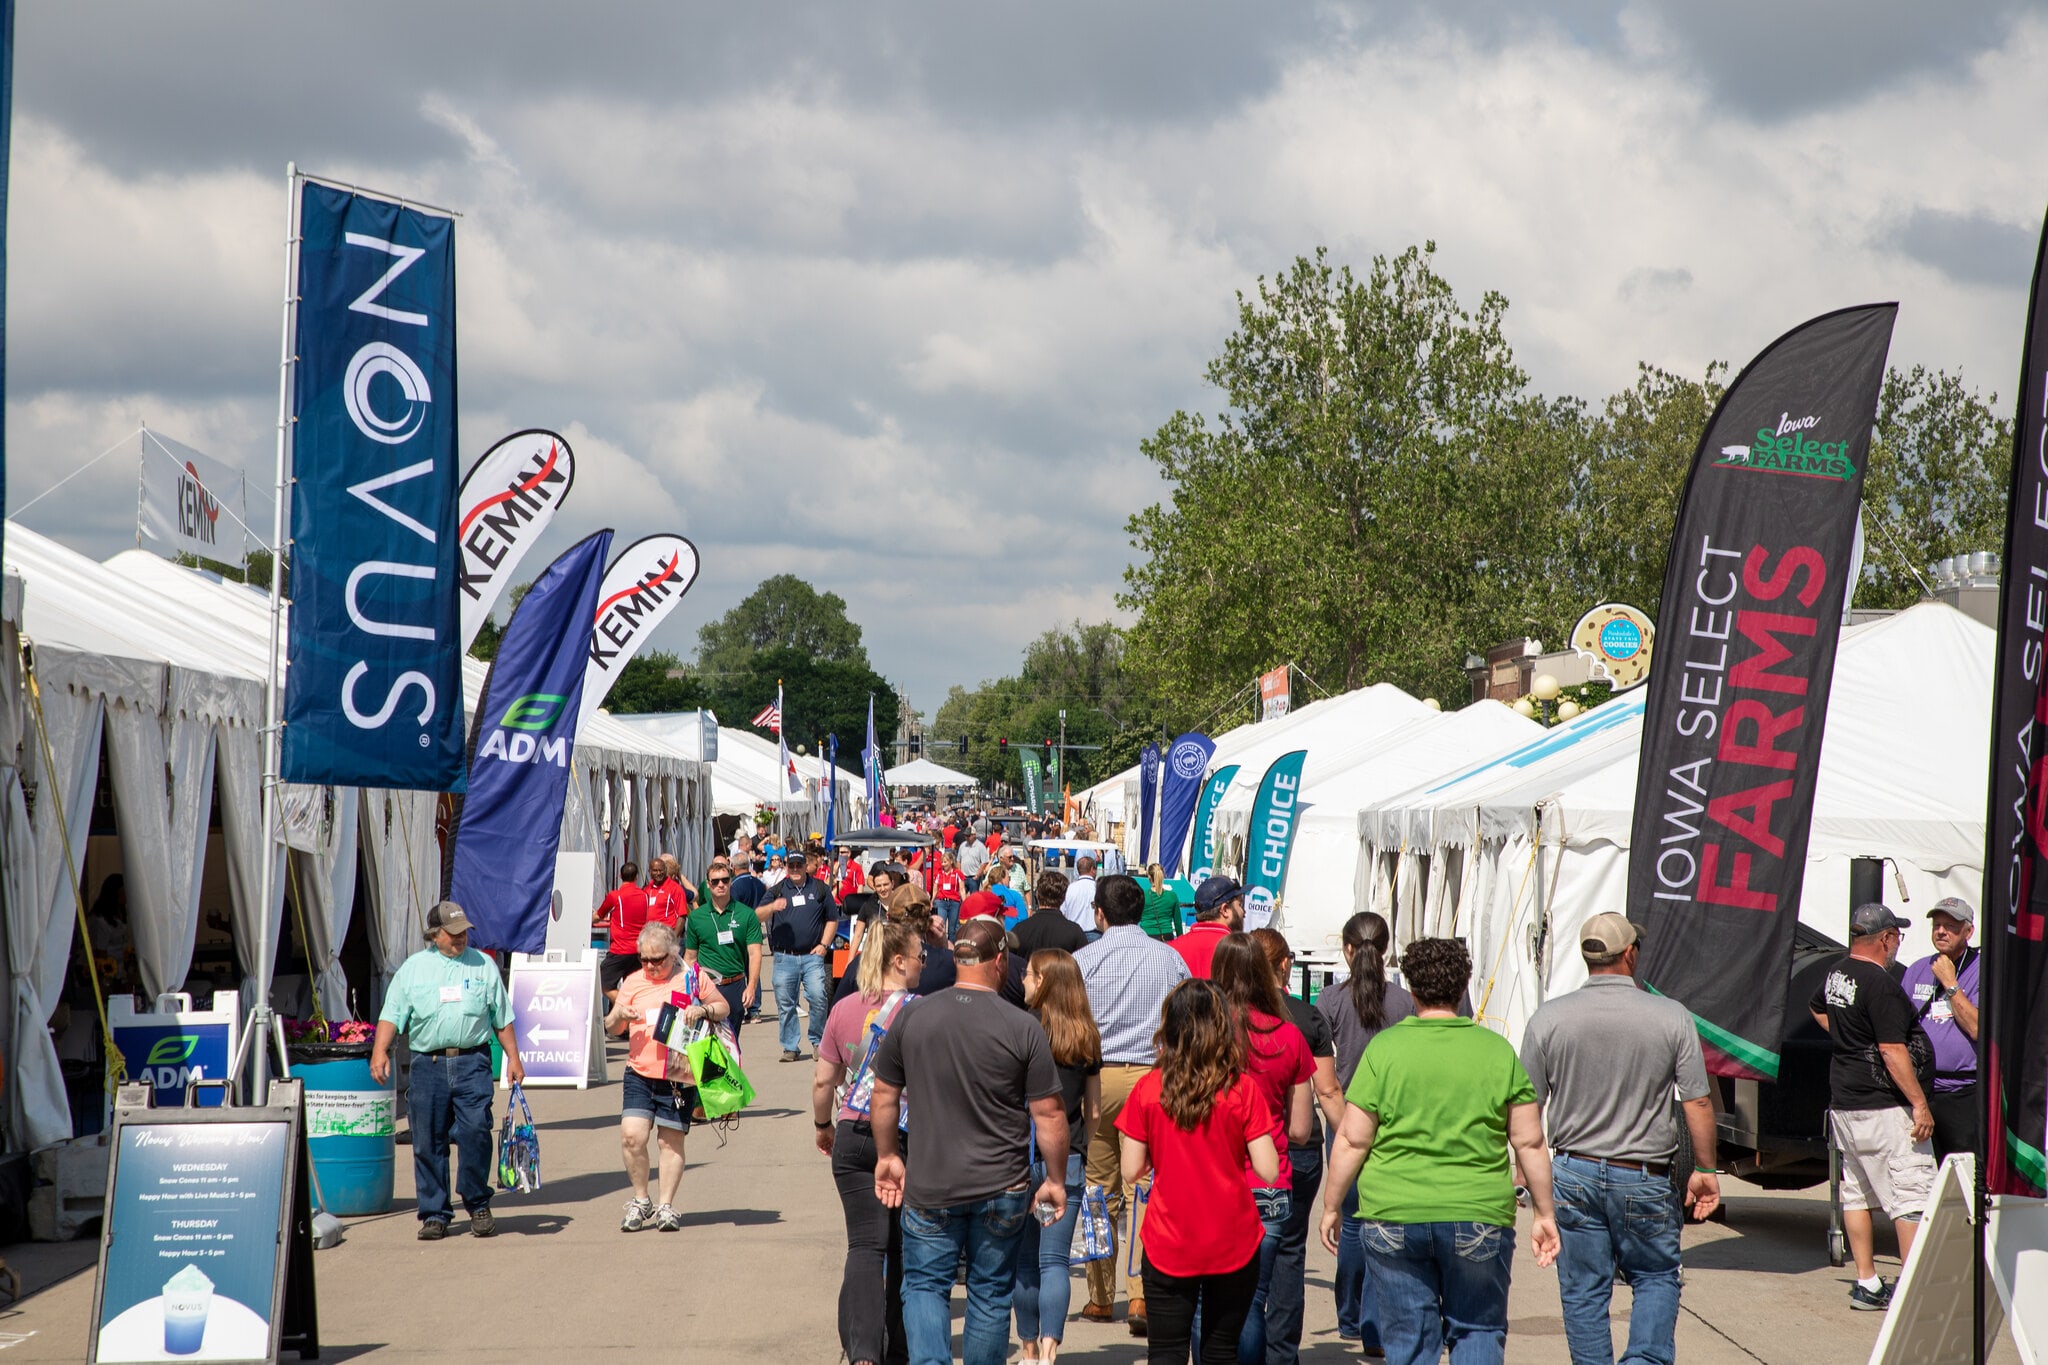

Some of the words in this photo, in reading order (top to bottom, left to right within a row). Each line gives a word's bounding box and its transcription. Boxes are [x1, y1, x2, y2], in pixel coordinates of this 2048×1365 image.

[1776, 411, 1821, 437] Iowa
[1754, 427, 1849, 458] Select
[1751, 450, 1848, 475] FARMS
[342, 231, 436, 729] NOVUS
[178, 474, 216, 546] KEMIN
[460, 453, 566, 601] KEMIN
[589, 558, 684, 671] KEMIN
[1676, 535, 1741, 739] SELECT
[1695, 543, 1827, 912] FARMS
[479, 729, 566, 768] ADM
[1177, 744, 1199, 756] PARTNER
[1261, 772, 1297, 878] CHOICE
[1654, 757, 1712, 901] IOWA
[1248, 902, 1273, 913] CHOICE
[527, 996, 573, 1012] ADM
[519, 1050, 580, 1063] NTRANCE
[139, 1065, 203, 1090] ADM
[172, 1163, 229, 1172] WEDNESDAY
[139, 1193, 160, 1201] Happy
[161, 1192, 178, 1200] Hour
[171, 1219, 218, 1229] THURSDAY
[159, 1249, 180, 1257] Happy
[171, 1303, 203, 1311] NOVUS
